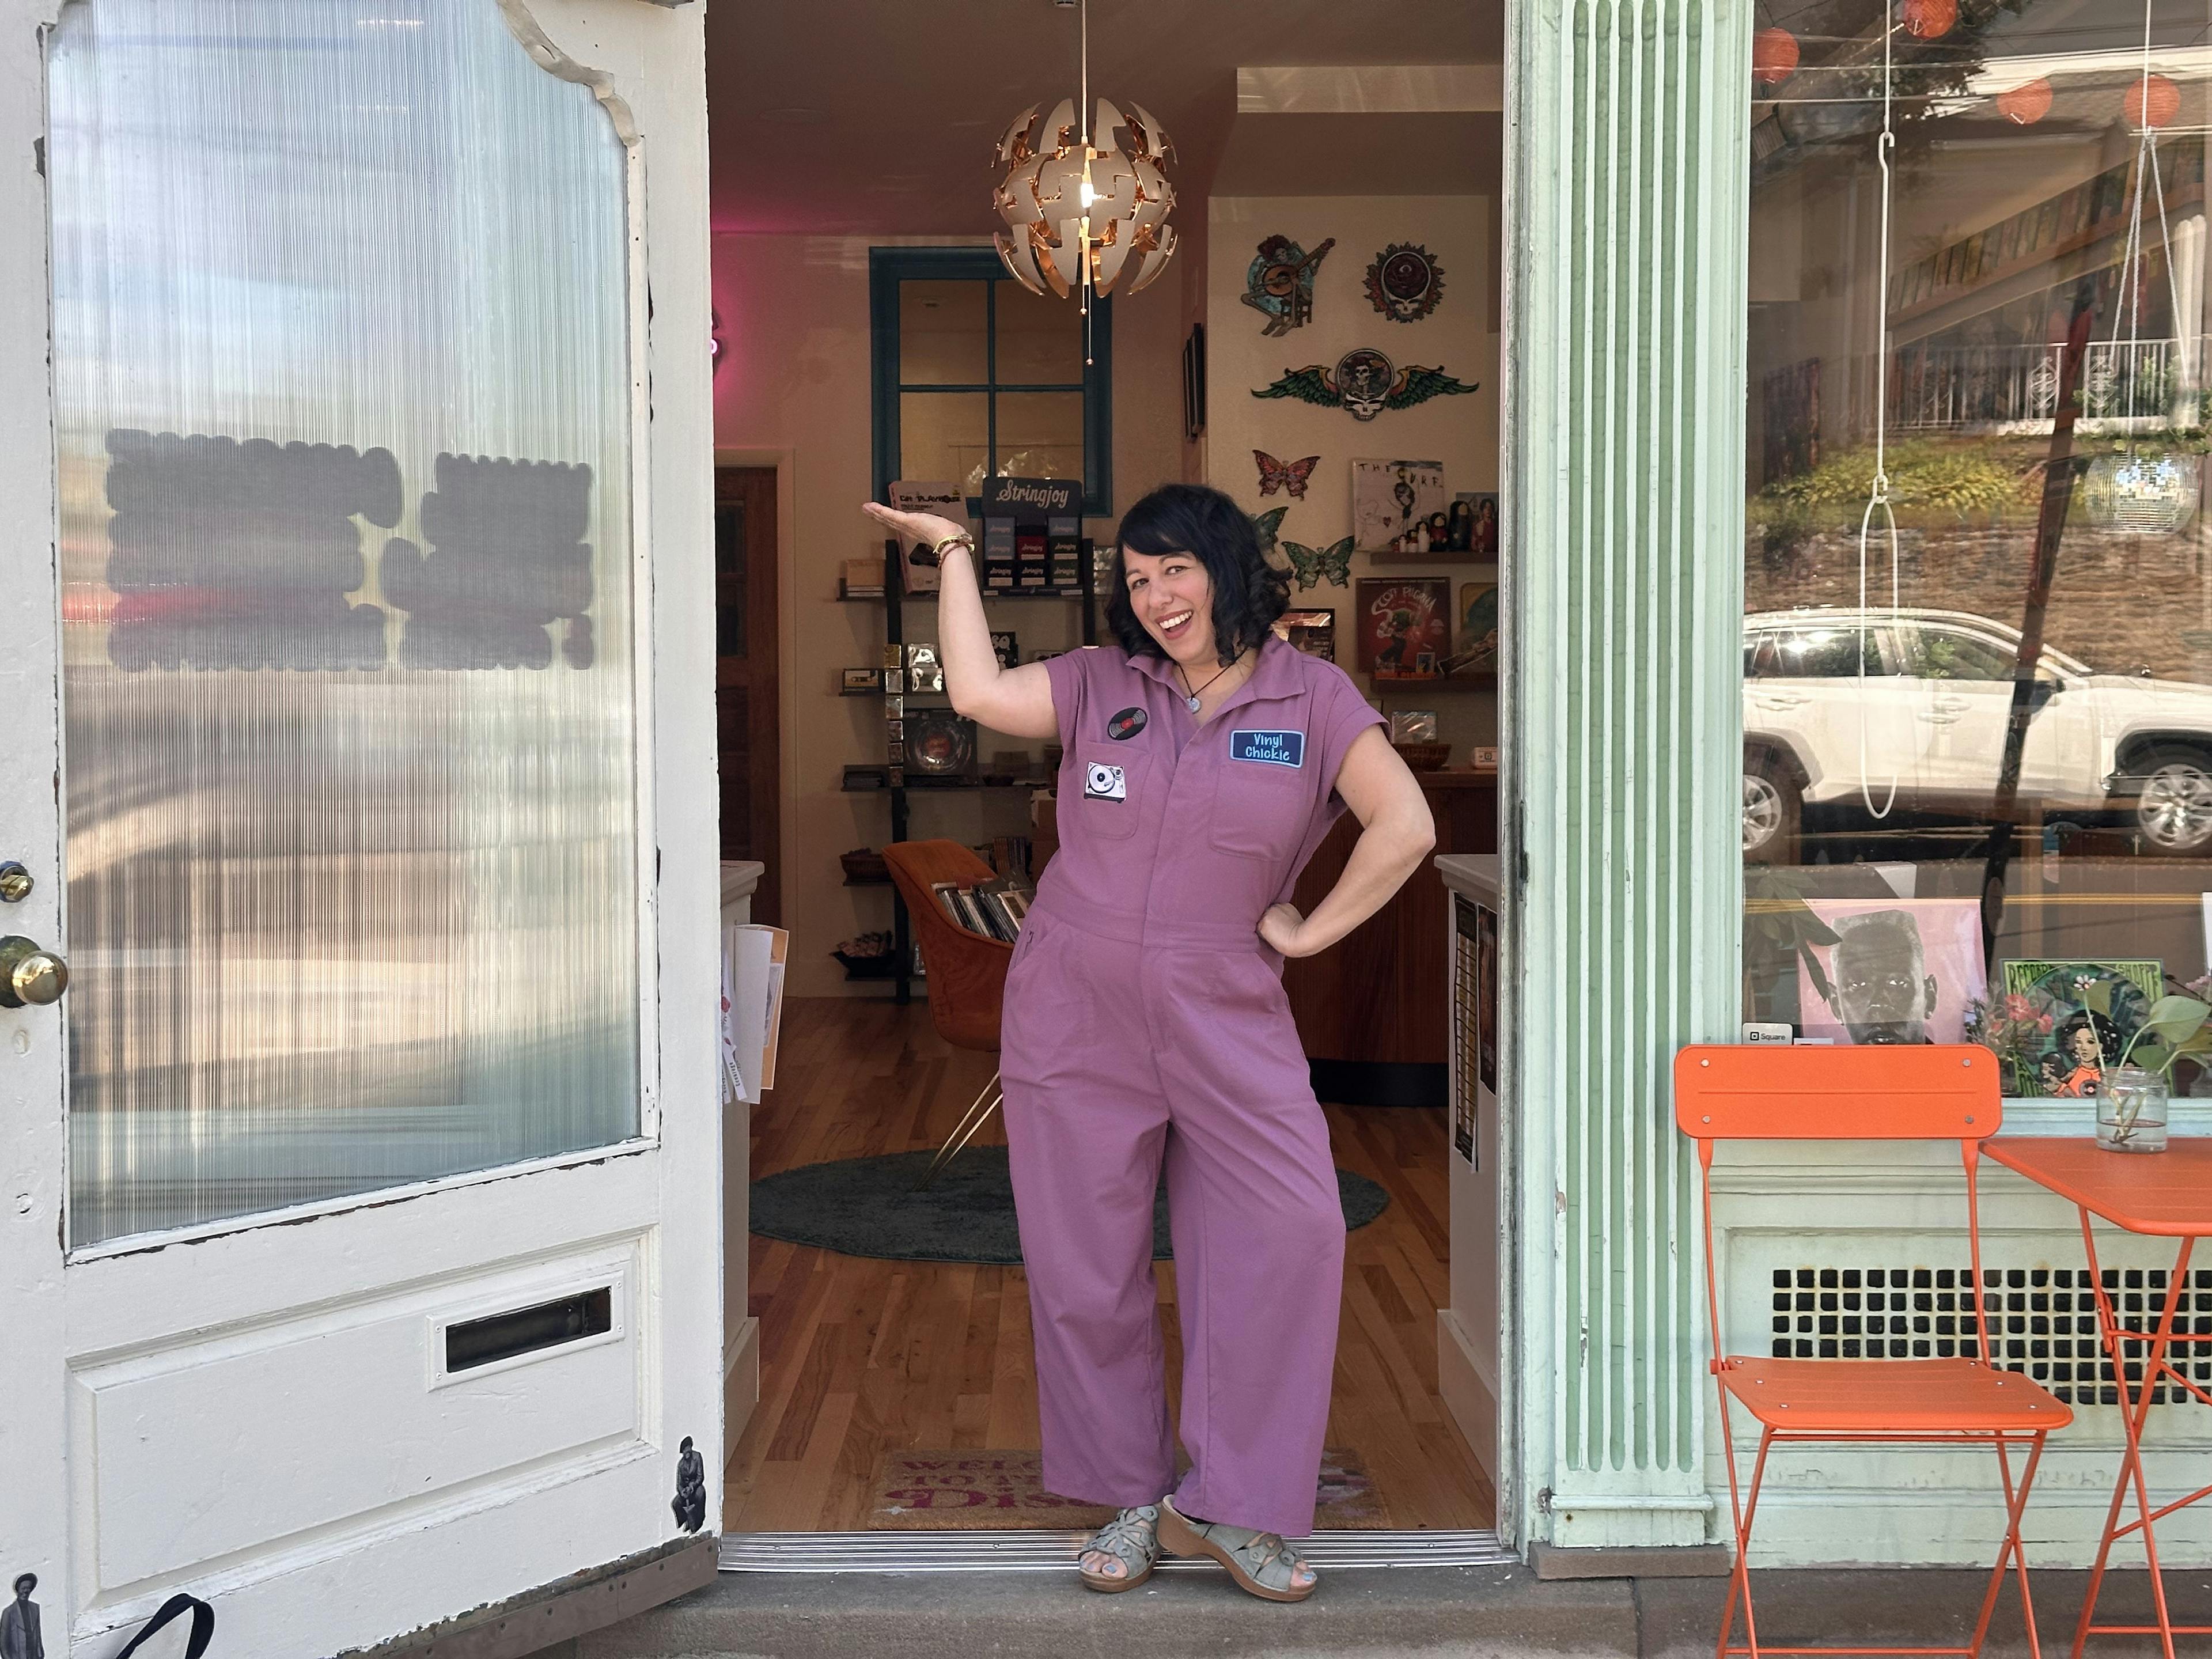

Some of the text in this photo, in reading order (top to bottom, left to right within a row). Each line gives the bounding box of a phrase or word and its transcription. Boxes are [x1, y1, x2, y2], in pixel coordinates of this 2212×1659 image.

[1358, 463, 1391, 472] THE
[996, 479, 1069, 509] Stringjoy
[1253, 733, 1283, 748] Vinyl
[1245, 746, 1290, 761] Chickie
[1760, 1033, 1786, 1041] Square
[902, 1460, 1043, 1470] WELC
